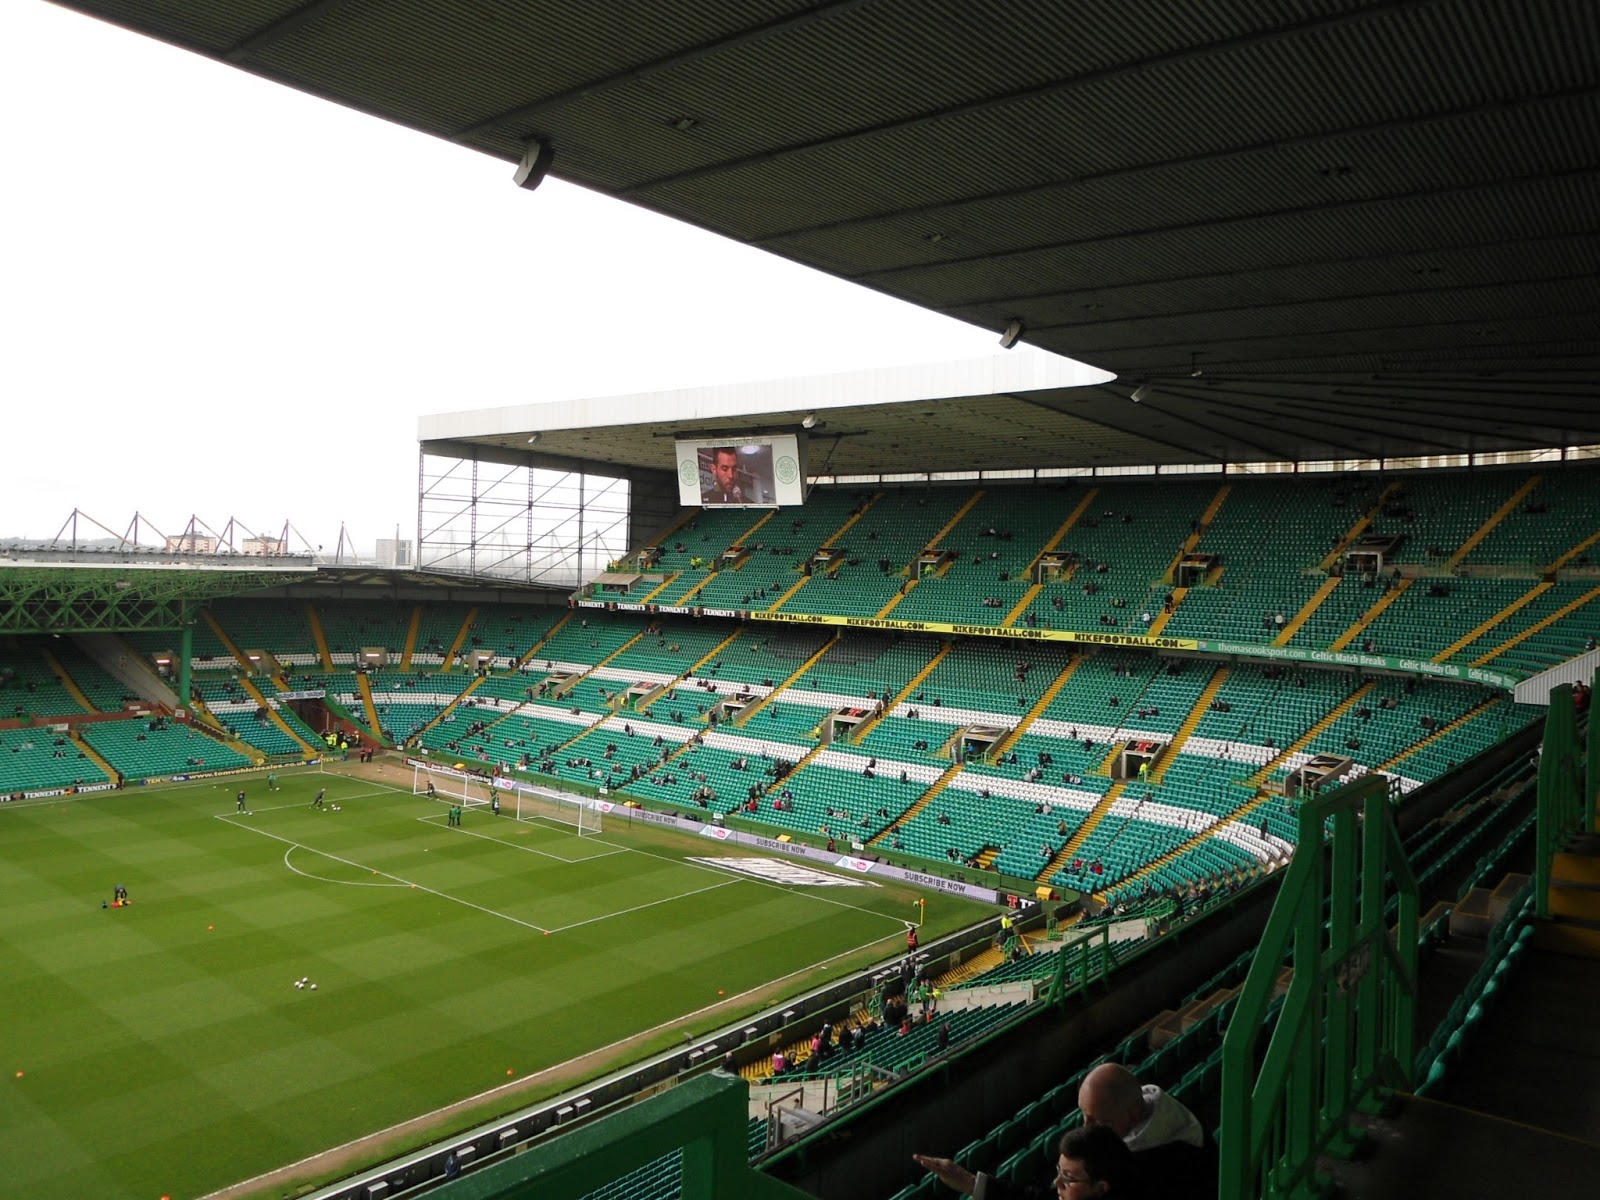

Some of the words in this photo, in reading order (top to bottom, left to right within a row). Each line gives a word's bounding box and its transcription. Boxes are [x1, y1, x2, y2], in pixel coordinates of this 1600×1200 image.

[578, 600, 605, 608] TENNENT'S
[617, 603, 645, 611] TENNENT'S
[659, 605, 689, 614] TENNENT'S
[703, 608, 735, 617] TENNENT'S
[755, 612, 822, 623] NIKEFOOTBALL.COM
[847, 618, 924, 630] NIKEFOOTBALL.COM
[952, 625, 1042, 638] NIKEFOOTBALL.COM
[1074, 633, 1178, 647] NIKEFOOTBALL.COM
[1218, 643, 1306, 659] thomascooksport.com
[1311, 651, 1333, 661] Celtic
[1335, 653, 1358, 664] Match
[1360, 656, 1386, 666] Breaks
[1399, 659, 1419, 670] Celtic
[1420, 662, 1444, 675] Holiday
[1445, 665, 1459, 676] Club
[189, 760, 306, 780] www.tomvehiclesales.co.uk
[24, 789, 65, 800] TENNENT'S
[78, 783, 117, 793] TENNENT'S
[634, 810, 663, 821] SUBSCRIBE
[664, 816, 677, 825] NOW
[756, 838, 790, 852] SUBSCRIBE
[791, 846, 806, 855] NOW
[904, 871, 946, 888] SUBSCRIBE
[947, 882, 966, 893] NOW
